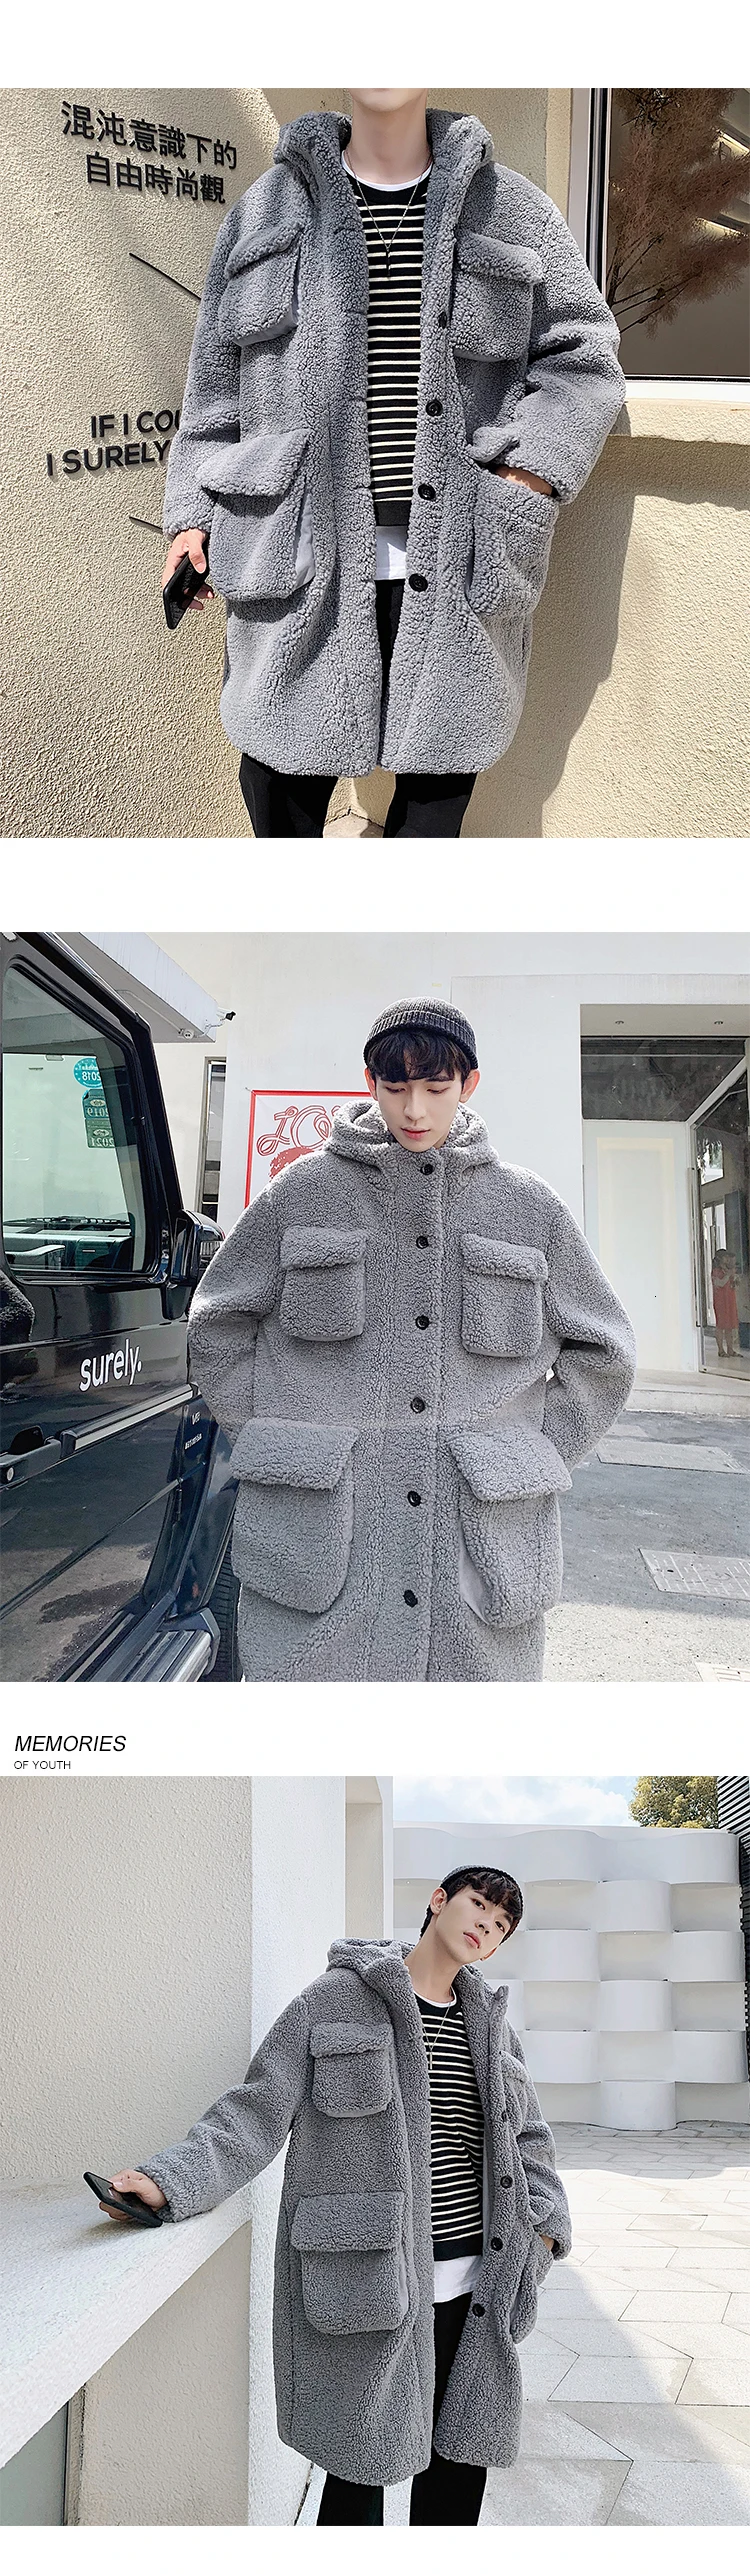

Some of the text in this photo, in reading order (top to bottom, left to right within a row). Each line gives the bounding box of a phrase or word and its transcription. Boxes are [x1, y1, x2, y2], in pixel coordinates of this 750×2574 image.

[61, 100, 237, 170] 混沌意識下的
[86, 151, 226, 204] 自由時尚觀
[91, 414, 115, 438] IF
[123, 413, 129, 436] I
[46, 439, 171, 477] I SURELY
[79, 1338, 142, 1391] surely.
